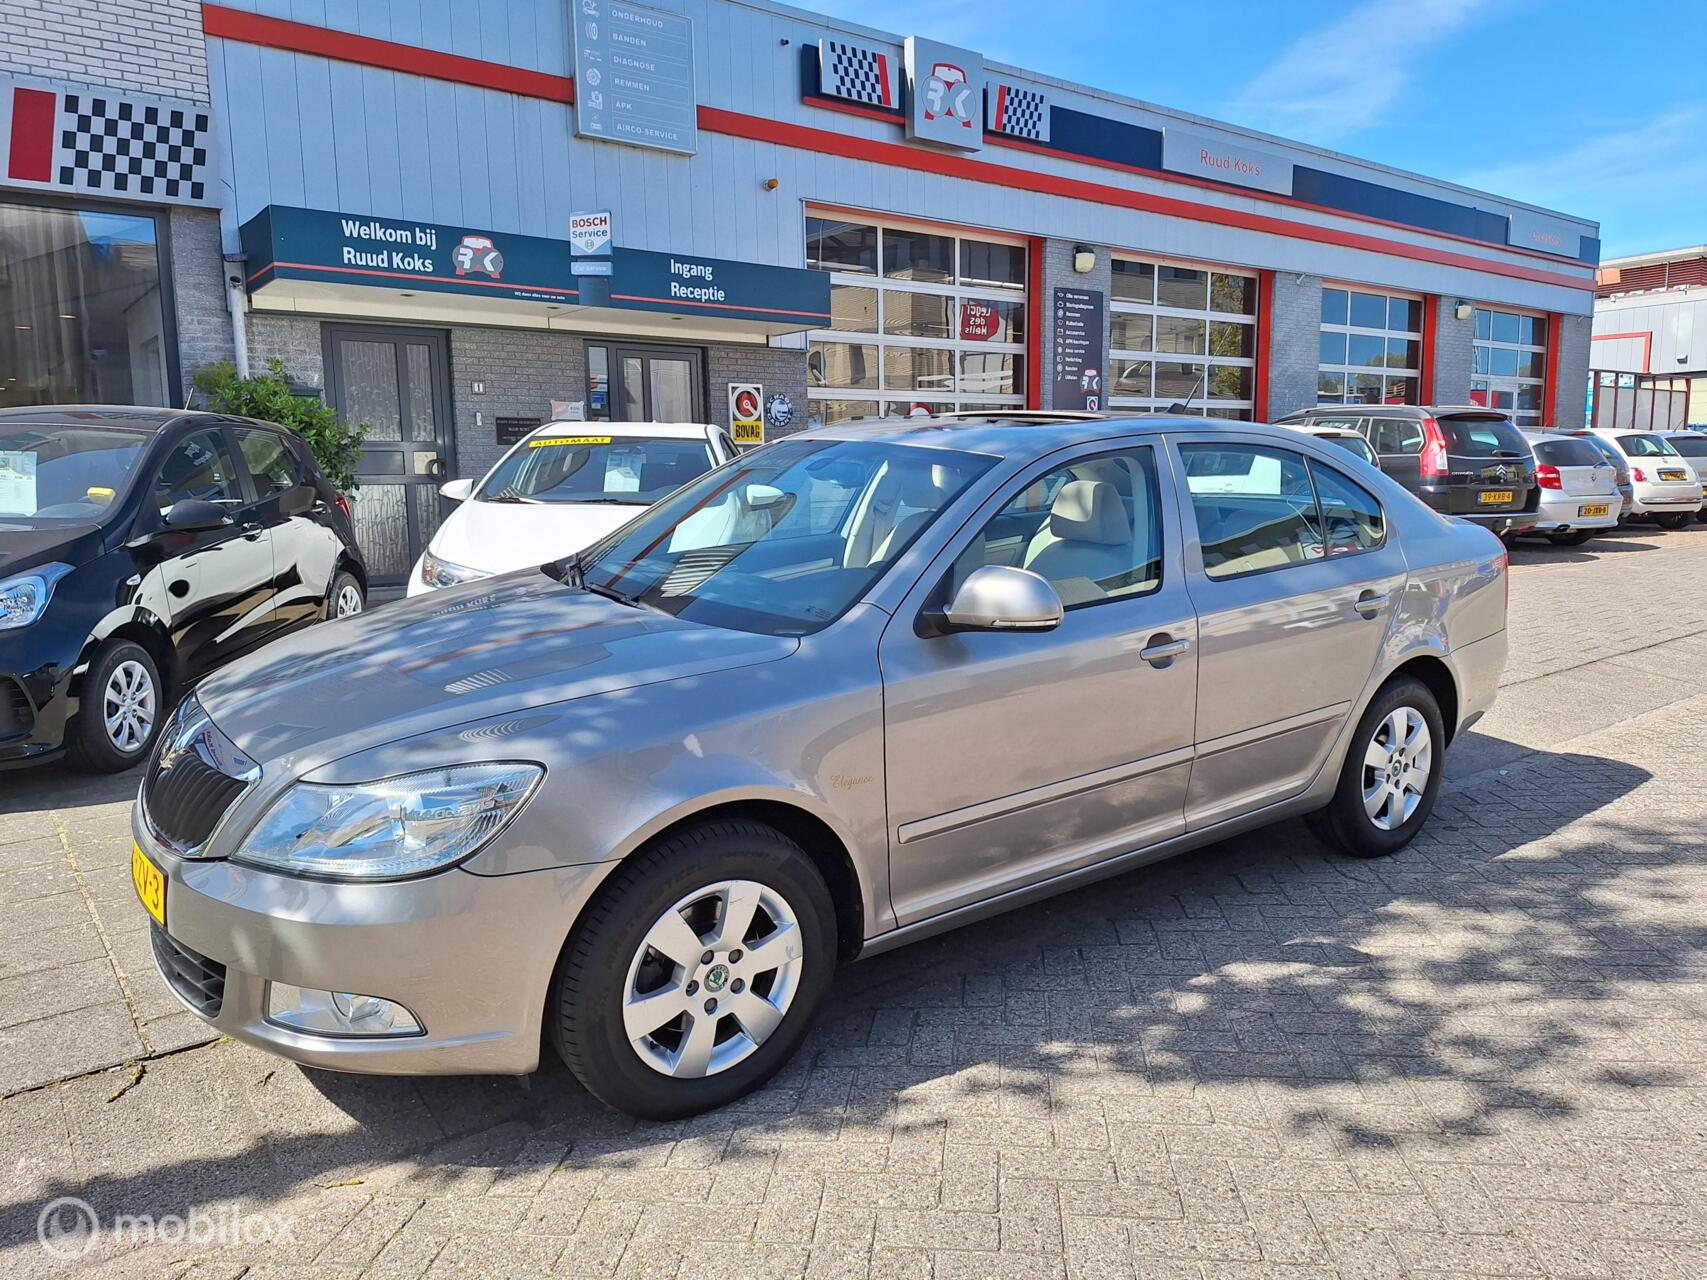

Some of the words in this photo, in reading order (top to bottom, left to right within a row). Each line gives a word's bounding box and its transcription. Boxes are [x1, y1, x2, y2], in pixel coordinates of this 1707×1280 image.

[611, 9, 664, 28] ONDERHOUD
[612, 32, 647, 47] BANDEN
[613, 55, 656, 71] DIAGNOSE
[614, 78, 650, 91] REMMEN
[615, 101, 633, 111] APK
[1200, 149, 1230, 169] Ruud
[1234, 158, 1262, 176] Koks
[572, 216, 608, 229] BOSCH
[341, 219, 412, 244] Welkom
[415, 227, 437, 250] bij
[572, 229, 608, 239] Service
[342, 246, 388, 268] Ruud
[392, 252, 434, 272] Koks
[670, 258, 713, 281] Ingang
[670, 281, 725, 302] Receptie
[735, 424, 760, 438] BOVAG
[535, 437, 607, 446] AUTOMAAT
[831, 775, 873, 790] Elegance
